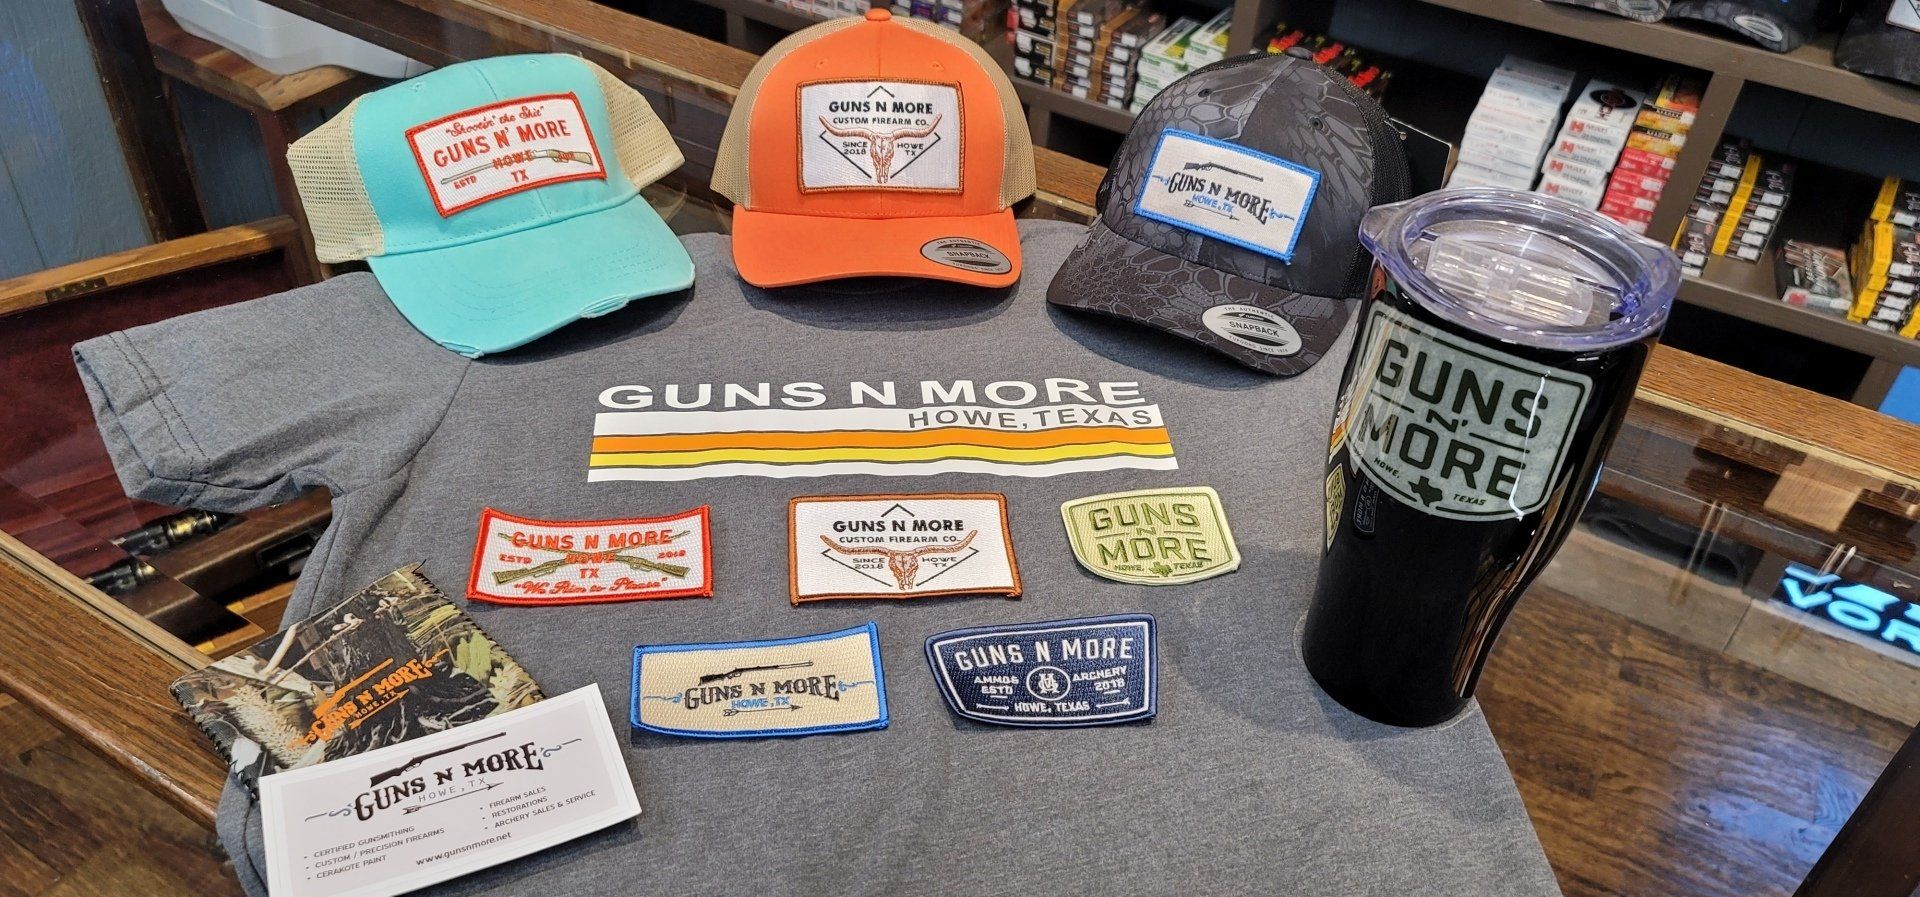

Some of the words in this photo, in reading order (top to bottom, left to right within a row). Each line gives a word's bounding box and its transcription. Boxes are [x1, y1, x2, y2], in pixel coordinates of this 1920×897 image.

[829, 101, 871, 113] GUNS
[876, 101, 887, 112] N
[892, 102, 933, 114] MORE
[833, 117, 869, 125] CUSTOM
[872, 117, 912, 126] FIREARM
[433, 136, 490, 167] GUNS
[517, 120, 571, 143] MORE
[492, 149, 534, 169] HOWE
[453, 175, 477, 190] ESTD
[511, 169, 529, 183] TX
[1168, 171, 1206, 193] GUNS
[1208, 181, 1221, 195] N
[1225, 186, 1272, 225] MORE
[946, 251, 991, 260] SNAPBACK
[1229, 321, 1280, 337] SNAPBACK
[598, 381, 827, 409] GUNS
[850, 380, 897, 406] N
[920, 377, 1146, 406] MORE
[1375, 338, 1549, 440] GUNS
[1033, 407, 1152, 428] TEXAS
[1357, 402, 1527, 501] MORE
[1453, 493, 1487, 506] TEXAS
[832, 520, 886, 532] GUNS
[893, 520, 906, 532] N
[912, 520, 964, 532] MORE
[1088, 502, 1200, 531] GUNS
[511, 531, 574, 550] GUNS
[584, 534, 598, 549] N
[608, 529, 673, 549] MORE
[499, 554, 533, 564] ESTD
[564, 552, 617, 564] HOWE
[1097, 537, 1212, 566] MORE
[579, 568, 600, 578] TX
[1173, 562, 1204, 571] TEXAS
[549, 580, 587, 594] Aim
[590, 584, 607, 593] to
[954, 643, 1024, 671] GUNS
[1035, 641, 1051, 662] N
[1062, 637, 1134, 661] MORE
[1072, 665, 1127, 682] ARCHERY
[684, 683, 743, 710] GUNS
[751, 682, 765, 695] N
[773, 674, 840, 702] MORE
[981, 685, 1013, 695] ESTD
[1094, 678, 1125, 691] 2018
[312, 701, 358, 741] GUNS
[356, 689, 374, 704] N
[372, 658, 433, 696] MORE
[1054, 701, 1091, 712] TEXAS
[354, 776, 426, 822] GUNS
[433, 767, 454, 786] N
[461, 741, 544, 778] MORE
[489, 794, 522, 809] FIREARM
[523, 786, 546, 798] SALES
[492, 795, 548, 818] RESTORATIONS
[494, 812, 530, 828] ARCHERY
[532, 803, 555, 816] SALES
[565, 789, 596, 805] SERVICE
[313, 842, 356, 858] CERTIFIED
[358, 825, 415, 847] GUNSMITHING
[315, 854, 351, 868] CUSTOM
[360, 839, 404, 856] PRECISION
[405, 827, 446, 844] FIREARMS
[415, 831, 512, 866] www.gunsnmore.net
[316, 863, 361, 880] CERAKOTE
[363, 854, 387, 867] PAINT
